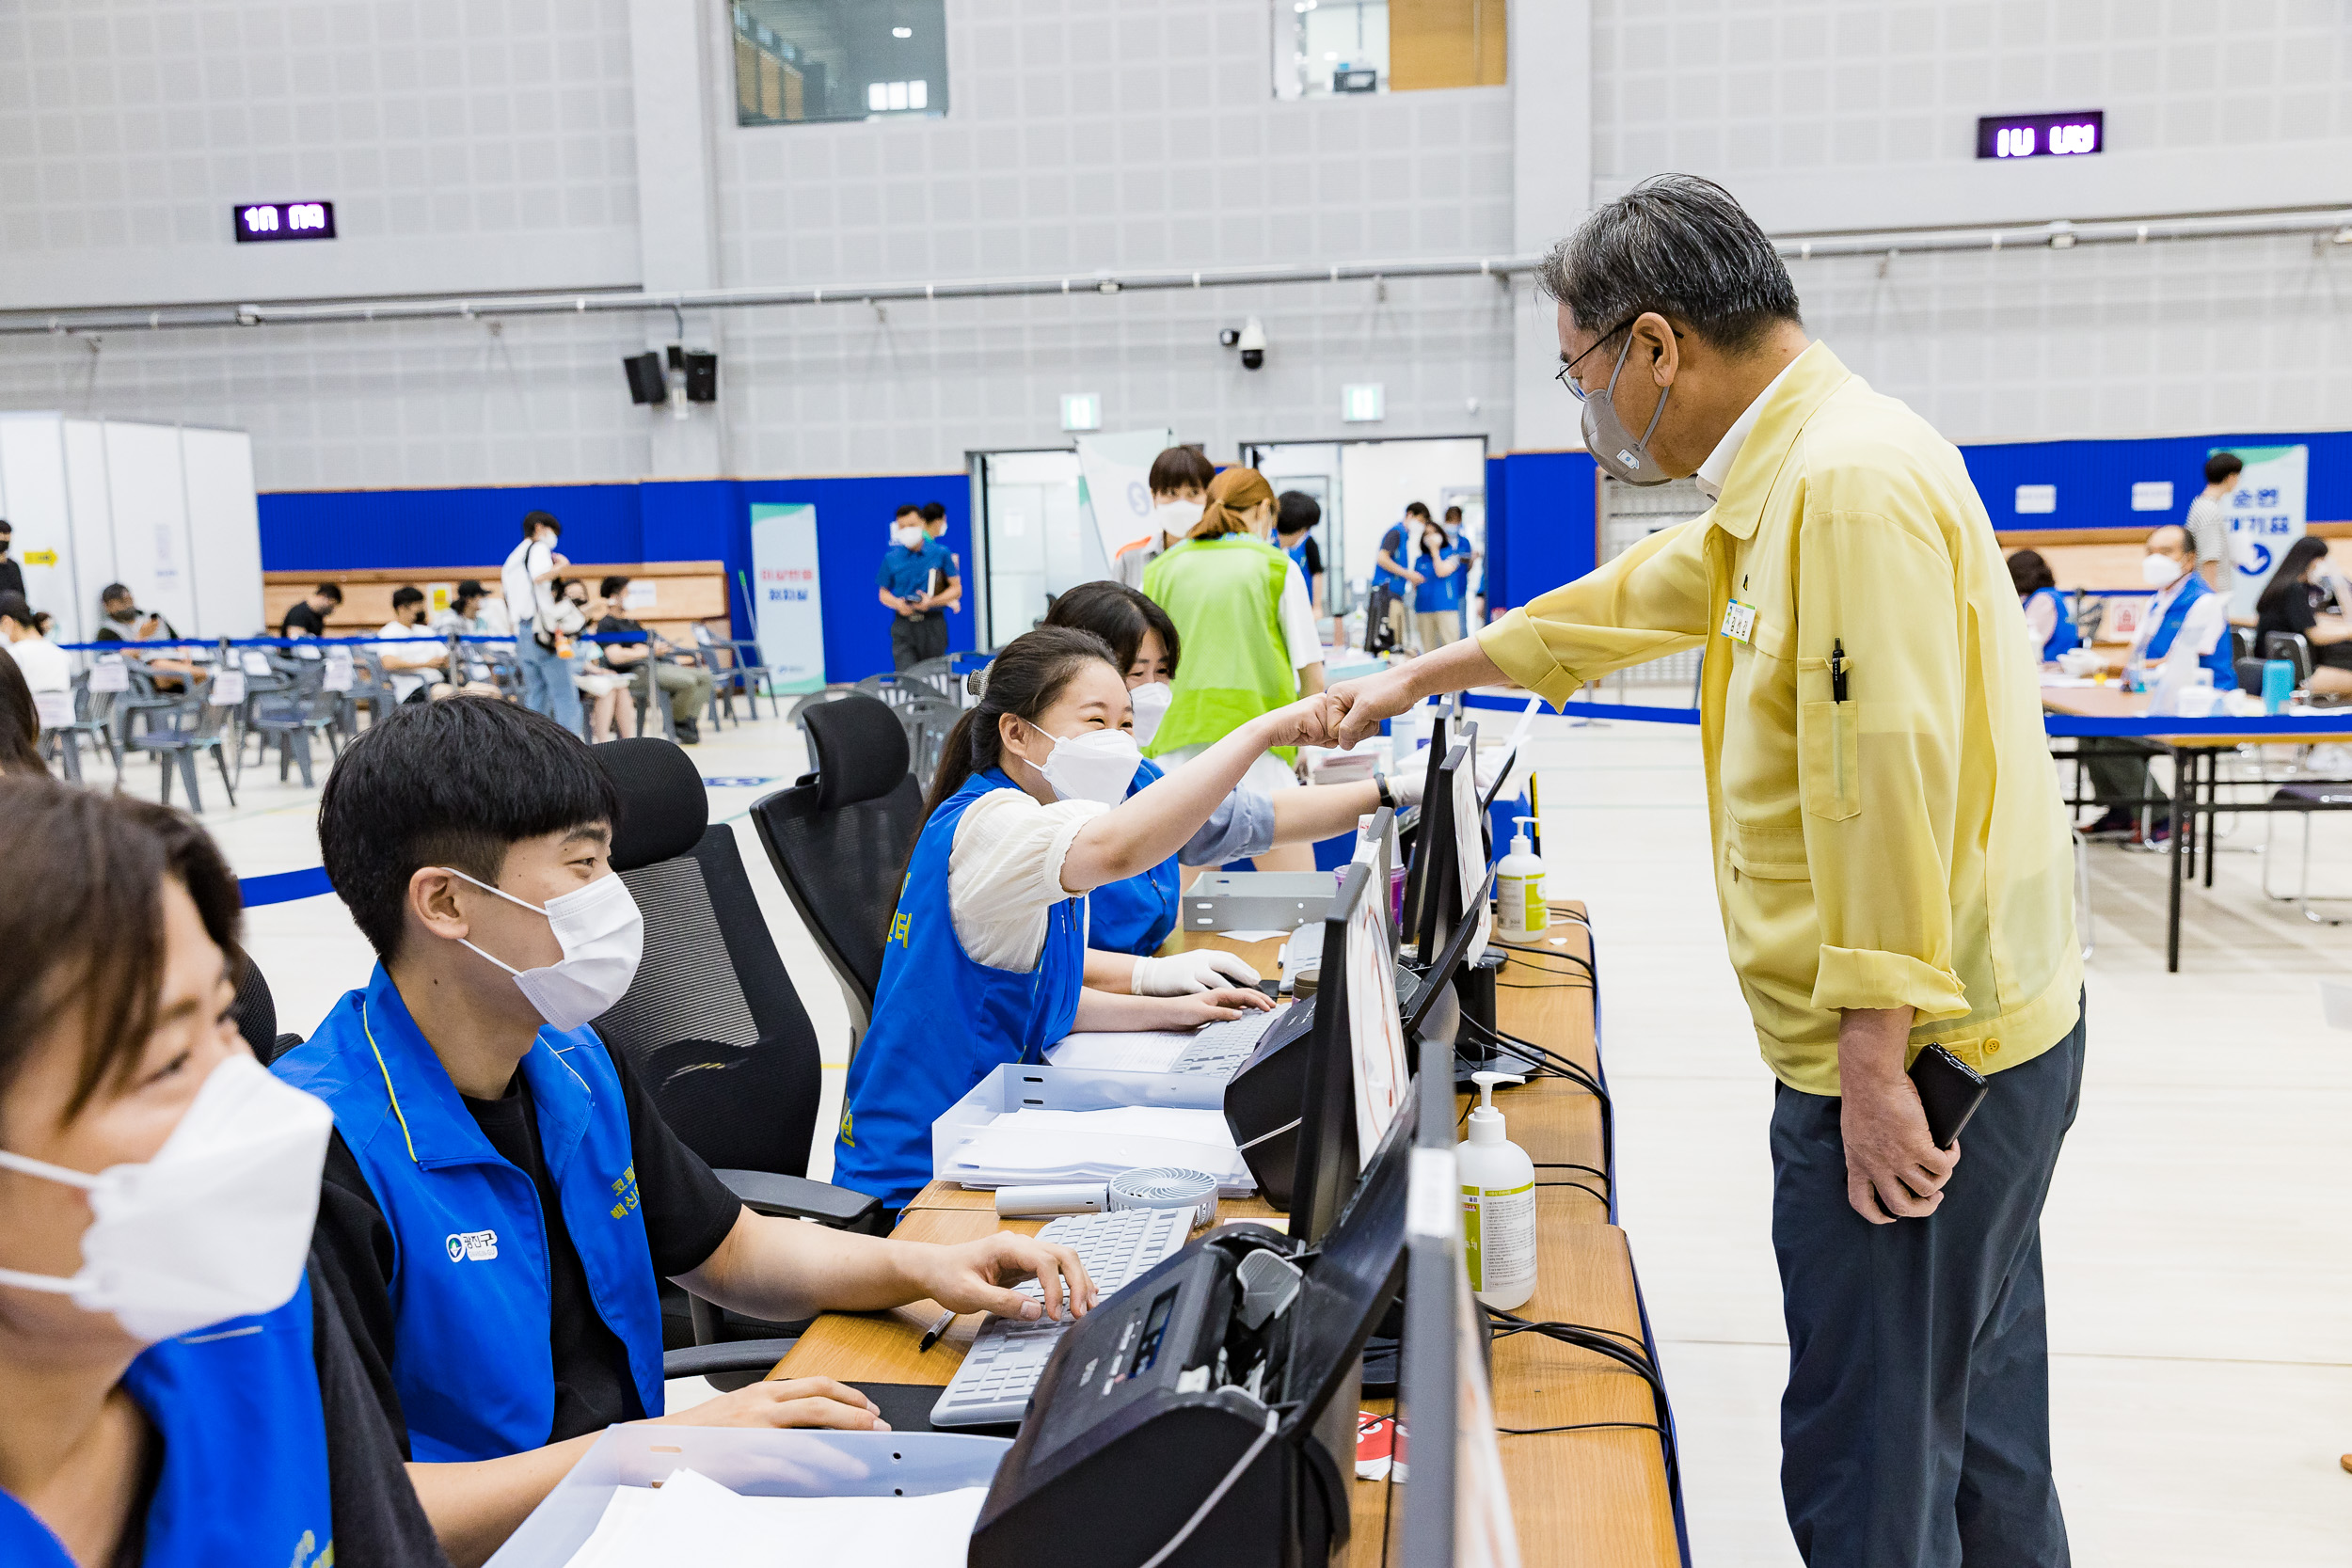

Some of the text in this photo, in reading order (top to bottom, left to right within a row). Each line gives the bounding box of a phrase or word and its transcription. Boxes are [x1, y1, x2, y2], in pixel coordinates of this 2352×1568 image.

[611, 1160, 636, 1197] 코로
[610, 1182, 641, 1220] 백신
[462, 1232, 494, 1249] 광진구
